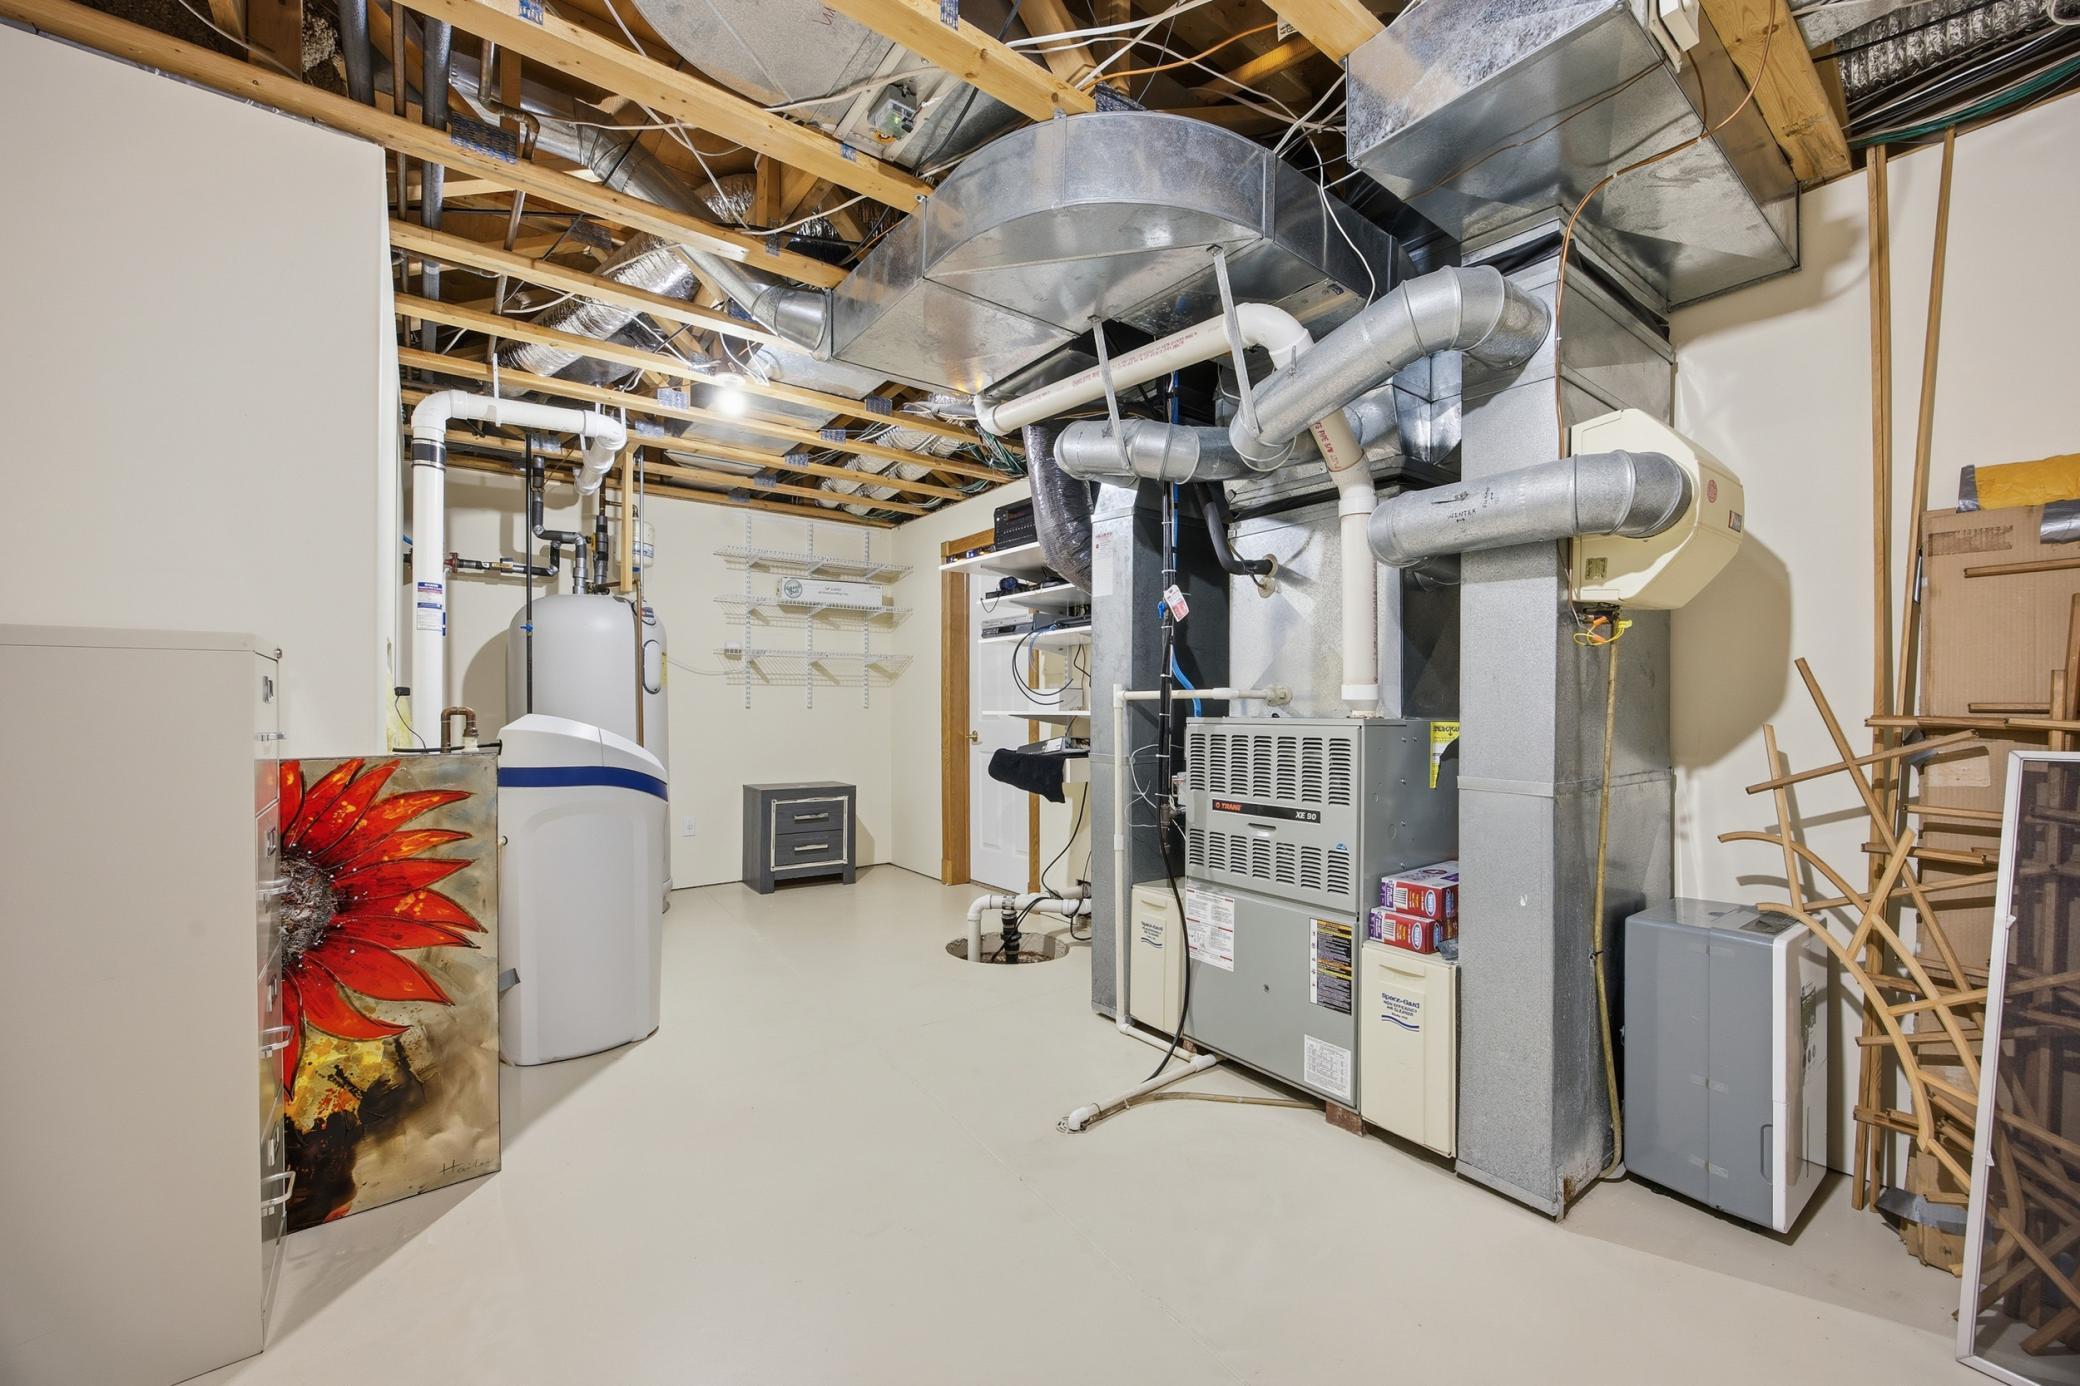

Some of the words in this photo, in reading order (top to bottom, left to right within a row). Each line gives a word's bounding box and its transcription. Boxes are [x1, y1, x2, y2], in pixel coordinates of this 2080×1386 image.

[1220, 803, 1242, 812] TRANE
[1295, 811, 1306, 820] XE
[1306, 812, 1317, 821] 90
